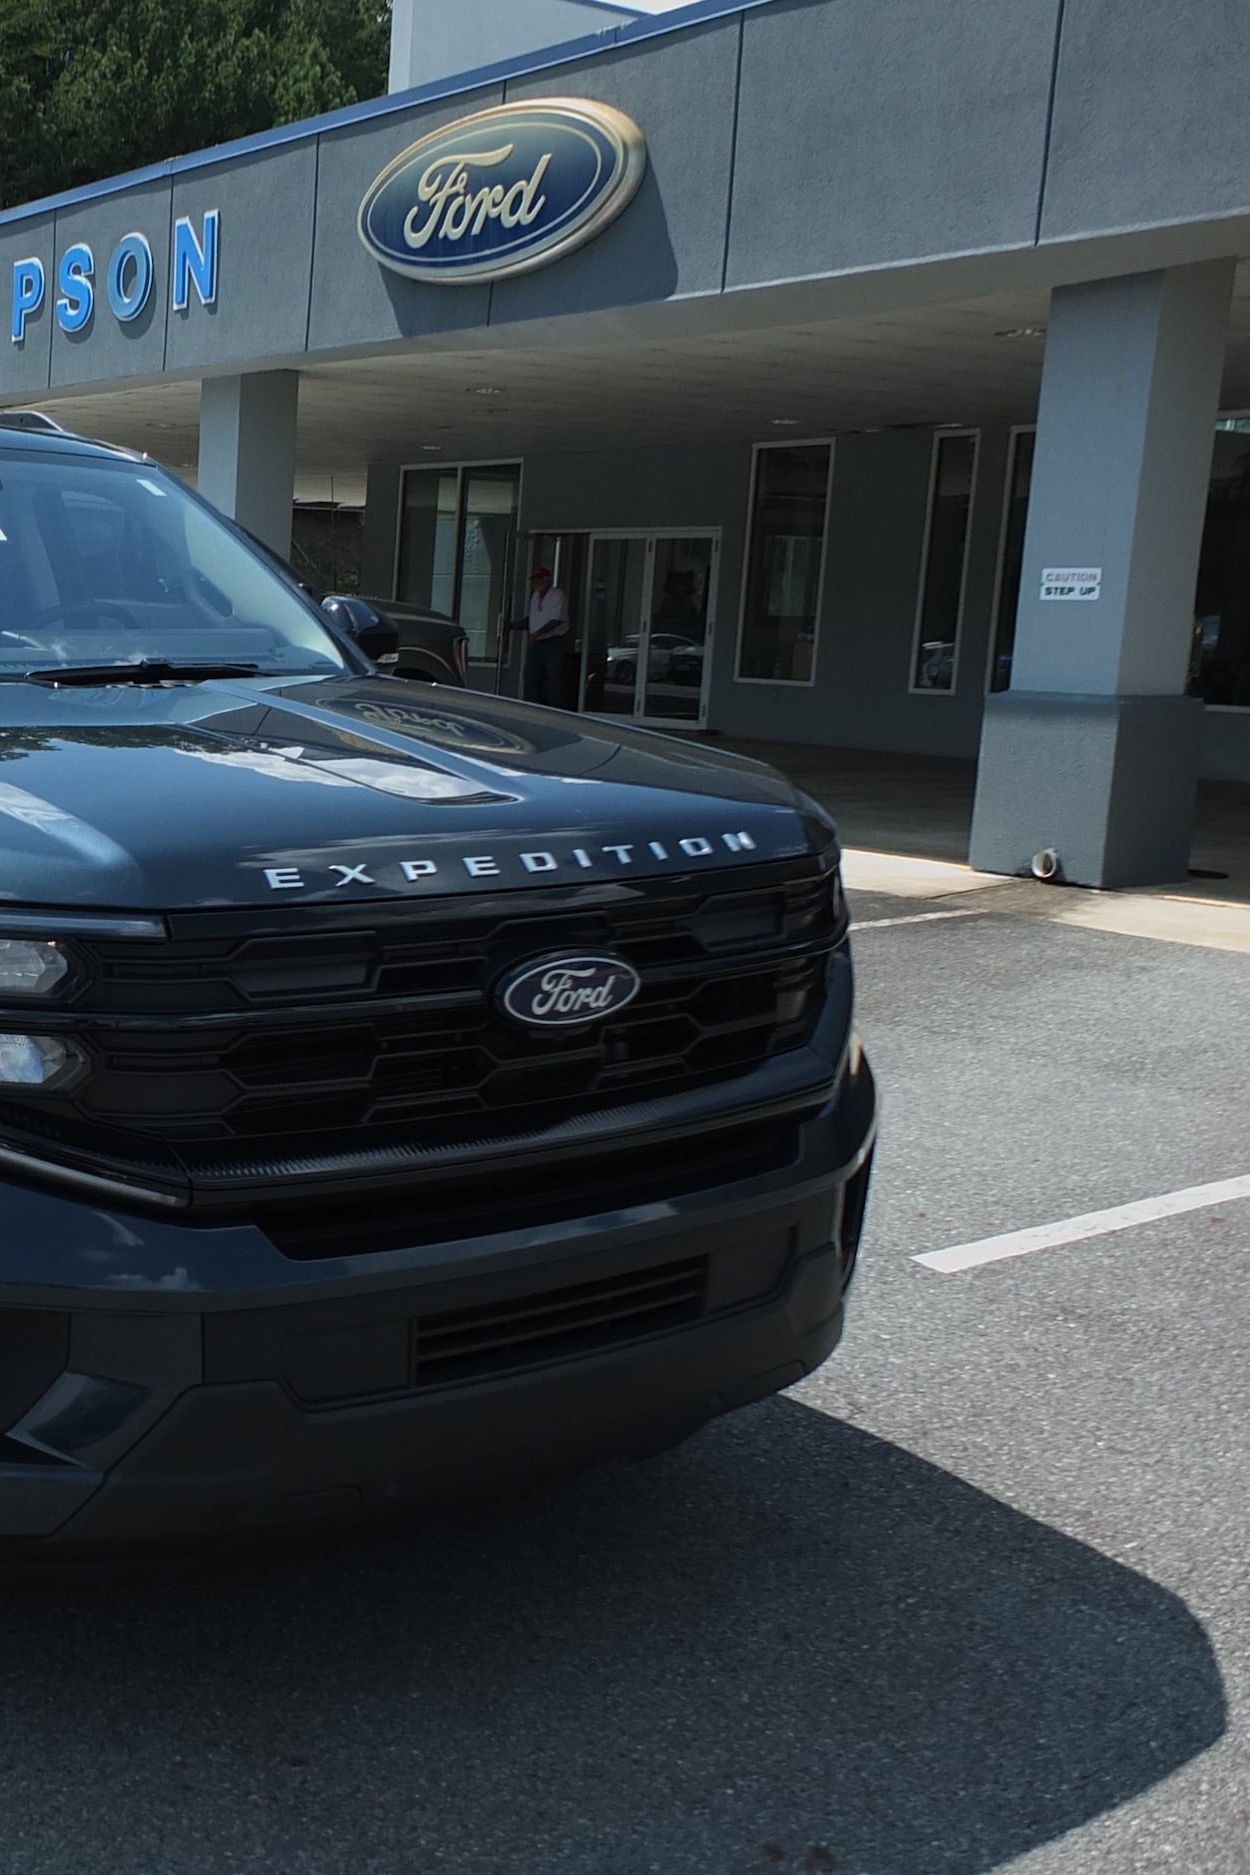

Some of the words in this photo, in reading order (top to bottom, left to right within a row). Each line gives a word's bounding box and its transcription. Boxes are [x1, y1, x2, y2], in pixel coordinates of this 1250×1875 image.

[404, 143, 552, 249] Ford
[1044, 586, 1075, 596] STEP
[1079, 586, 1097, 596] UP
[1045, 572, 1098, 582] CAUTION
[265, 830, 758, 890] EXPEDITION
[531, 967, 616, 1016] Ford
